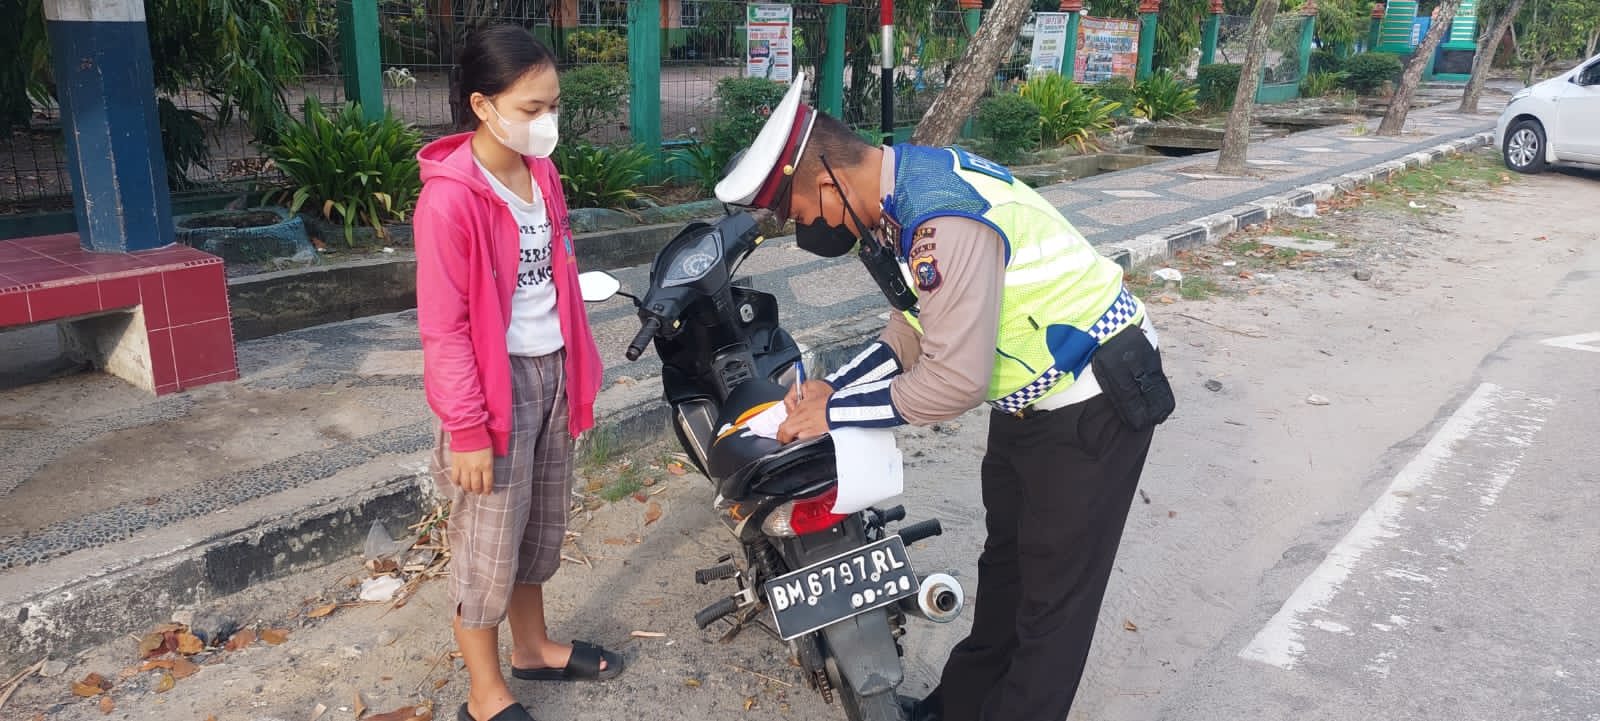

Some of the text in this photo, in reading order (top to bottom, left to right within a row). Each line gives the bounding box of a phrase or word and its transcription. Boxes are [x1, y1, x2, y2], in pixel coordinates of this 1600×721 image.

[773, 547, 904, 611] BM 6797 RL
